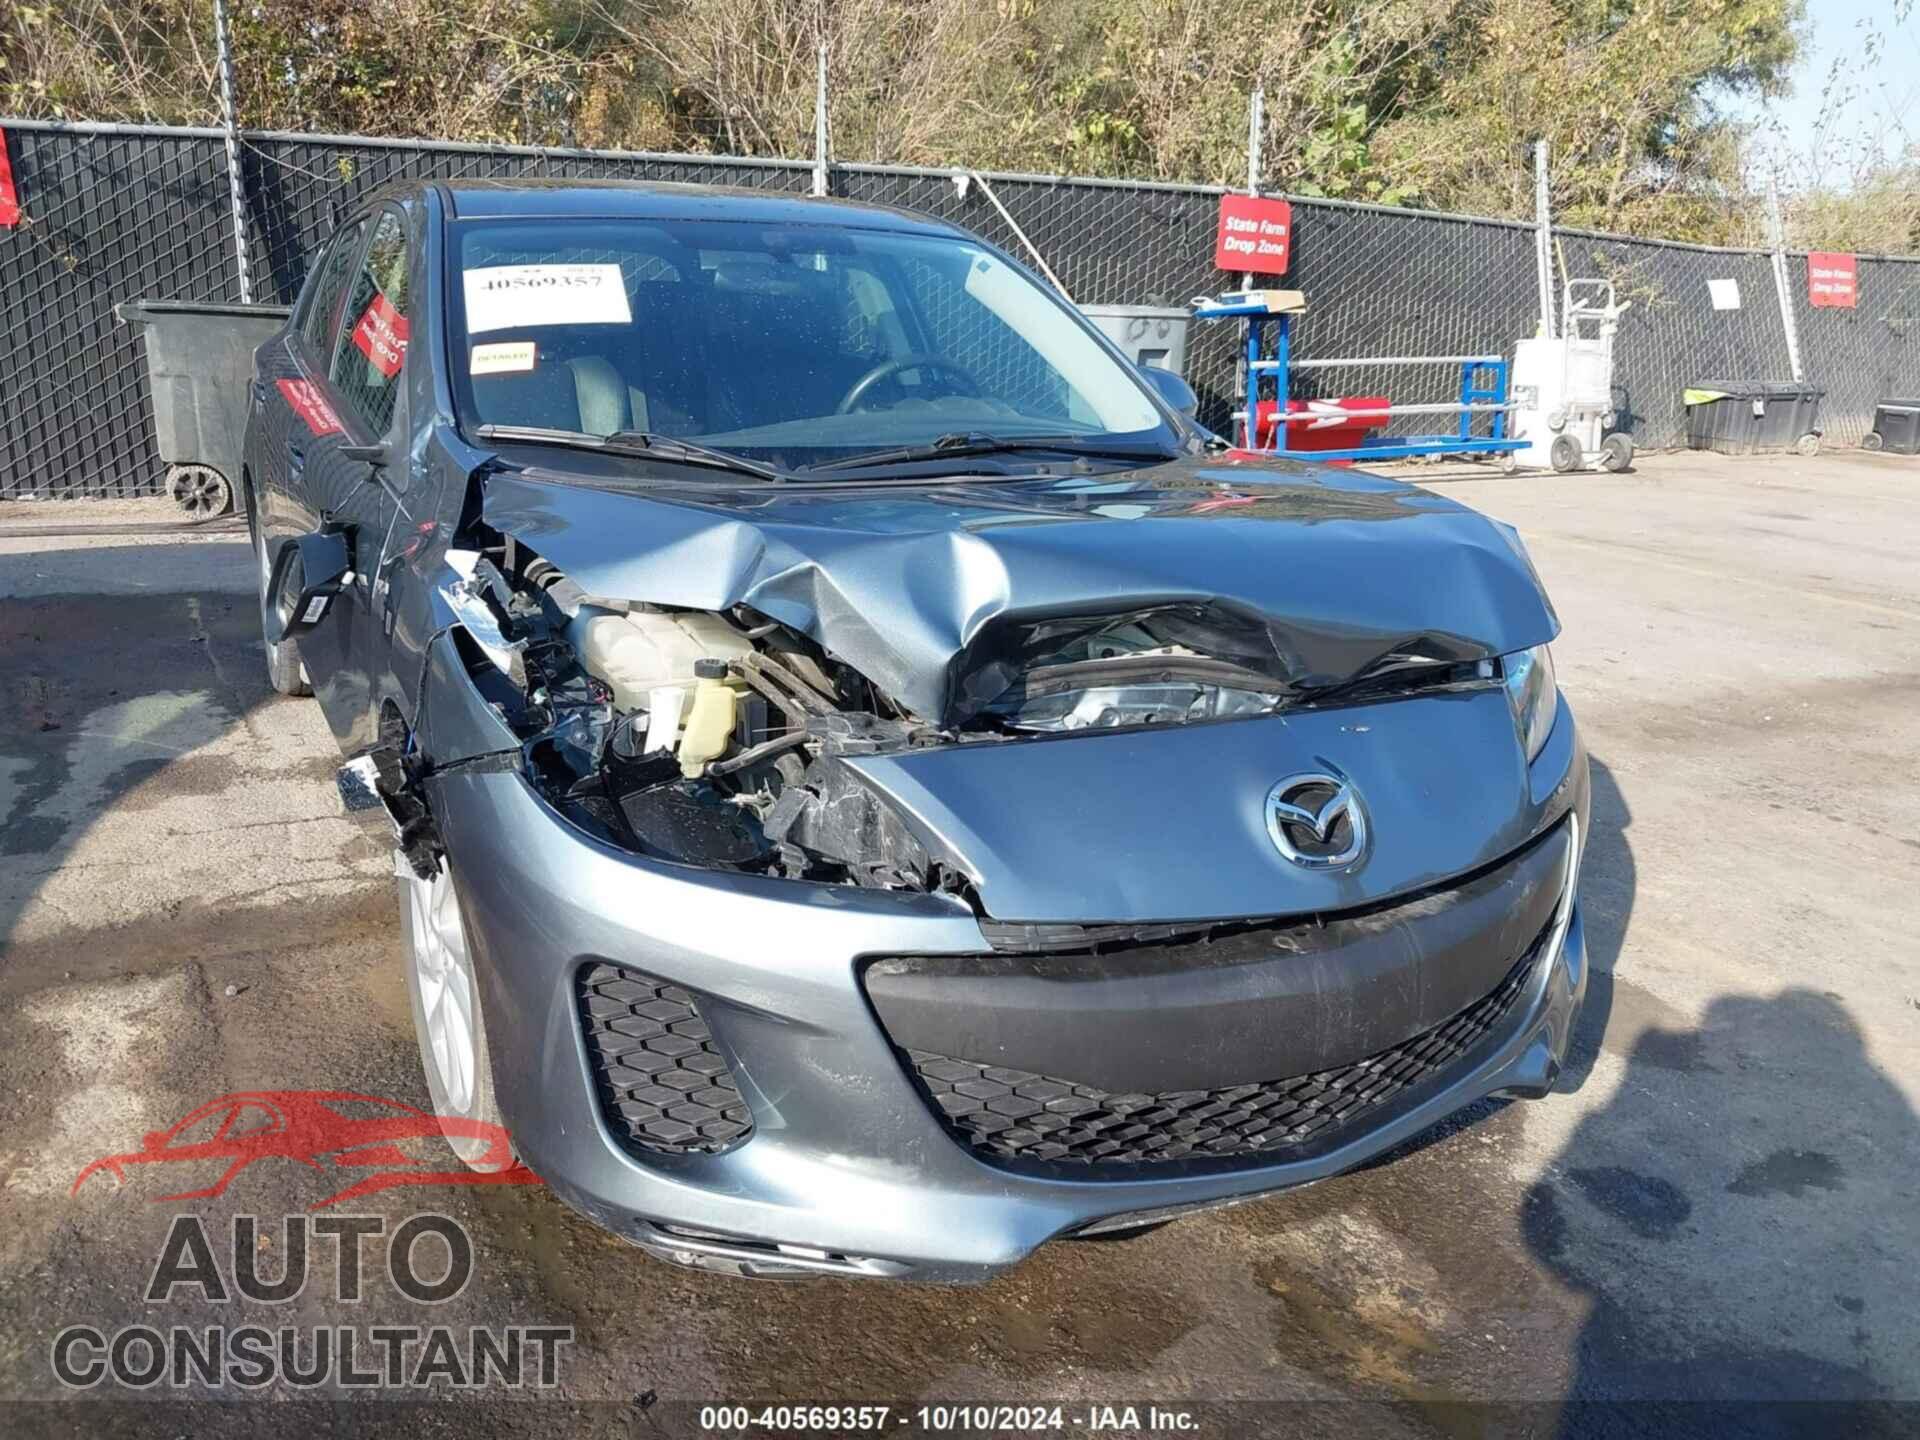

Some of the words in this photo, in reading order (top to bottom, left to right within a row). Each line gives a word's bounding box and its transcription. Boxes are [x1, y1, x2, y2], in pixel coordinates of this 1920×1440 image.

[1225, 216, 1258, 233] State
[1260, 219, 1286, 236] Farm
[1224, 236, 1255, 255] Drop
[1256, 239, 1284, 256] Zone
[480, 275, 602, 291] 40569357
